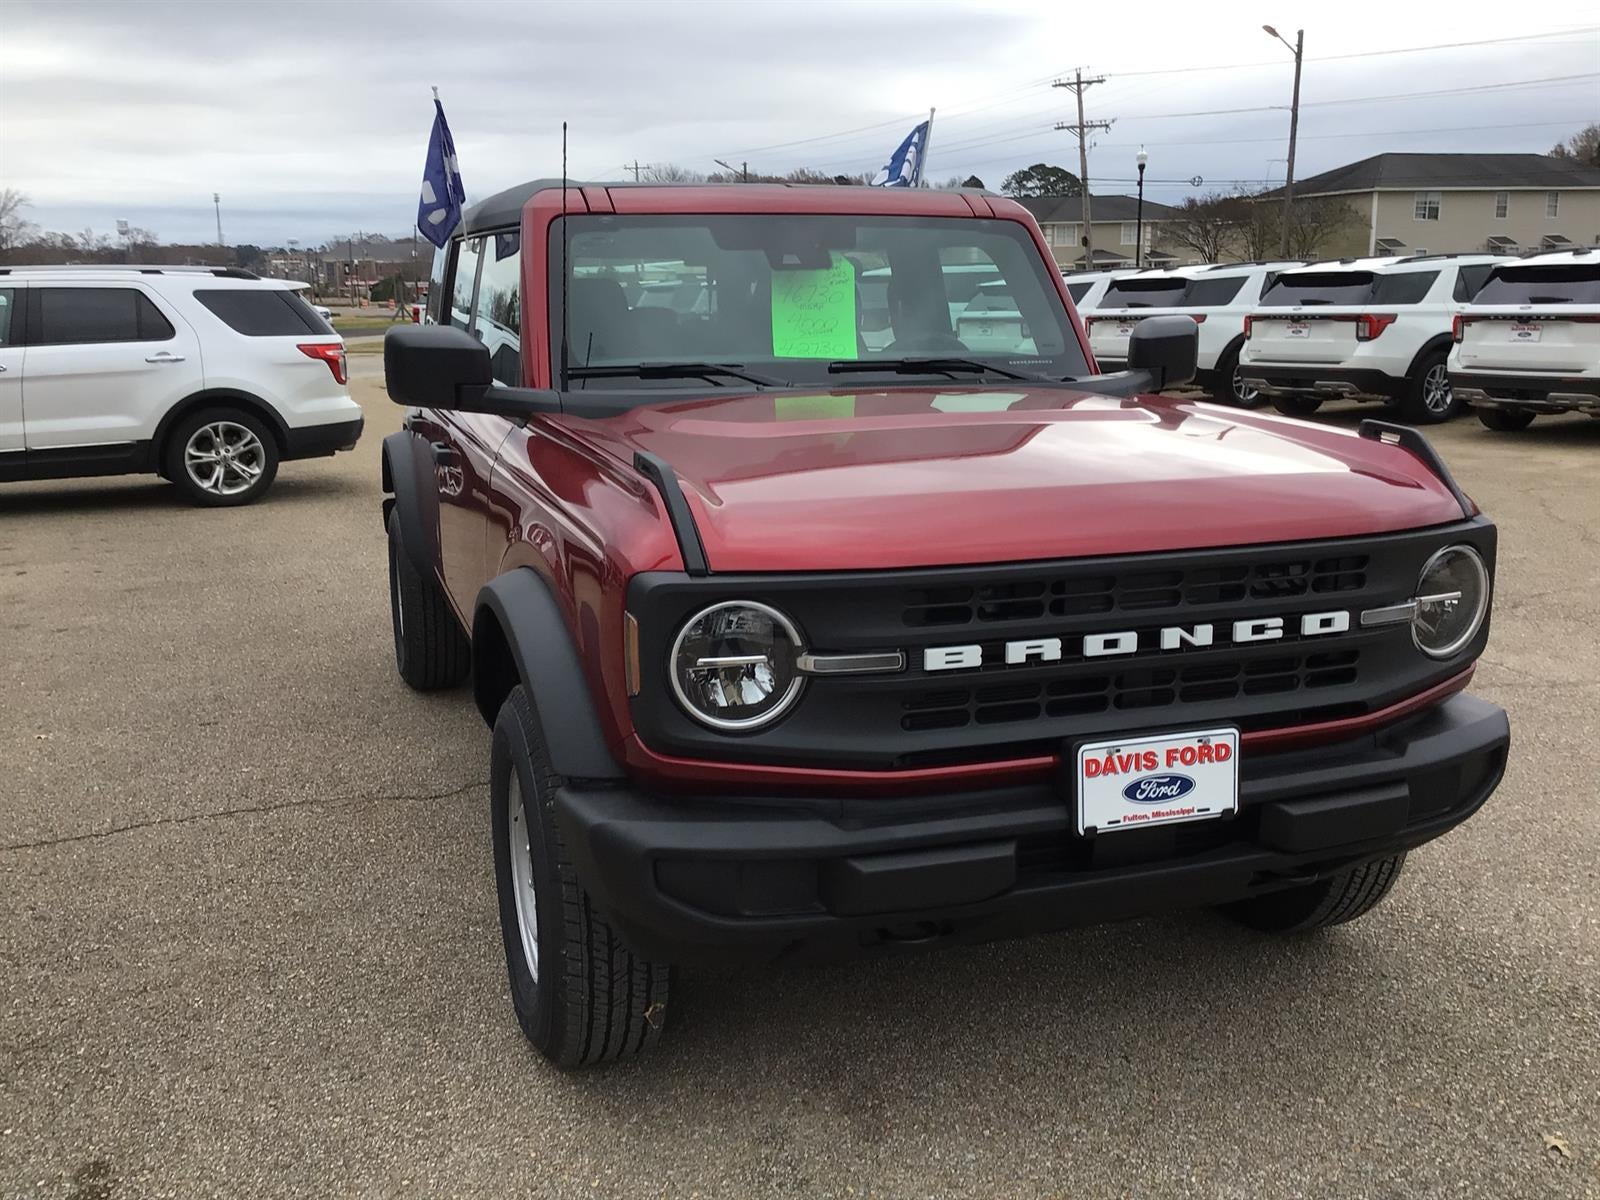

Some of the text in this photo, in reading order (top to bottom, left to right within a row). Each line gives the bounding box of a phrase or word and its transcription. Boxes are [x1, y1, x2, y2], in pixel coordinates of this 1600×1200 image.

[923, 610, 1350, 671] BRONCO
[1085, 743, 1232, 778] DAVIS FORD
[1135, 777, 1181, 800] Ford
[1122, 807, 1195, 824] Fulton, Mississippi
